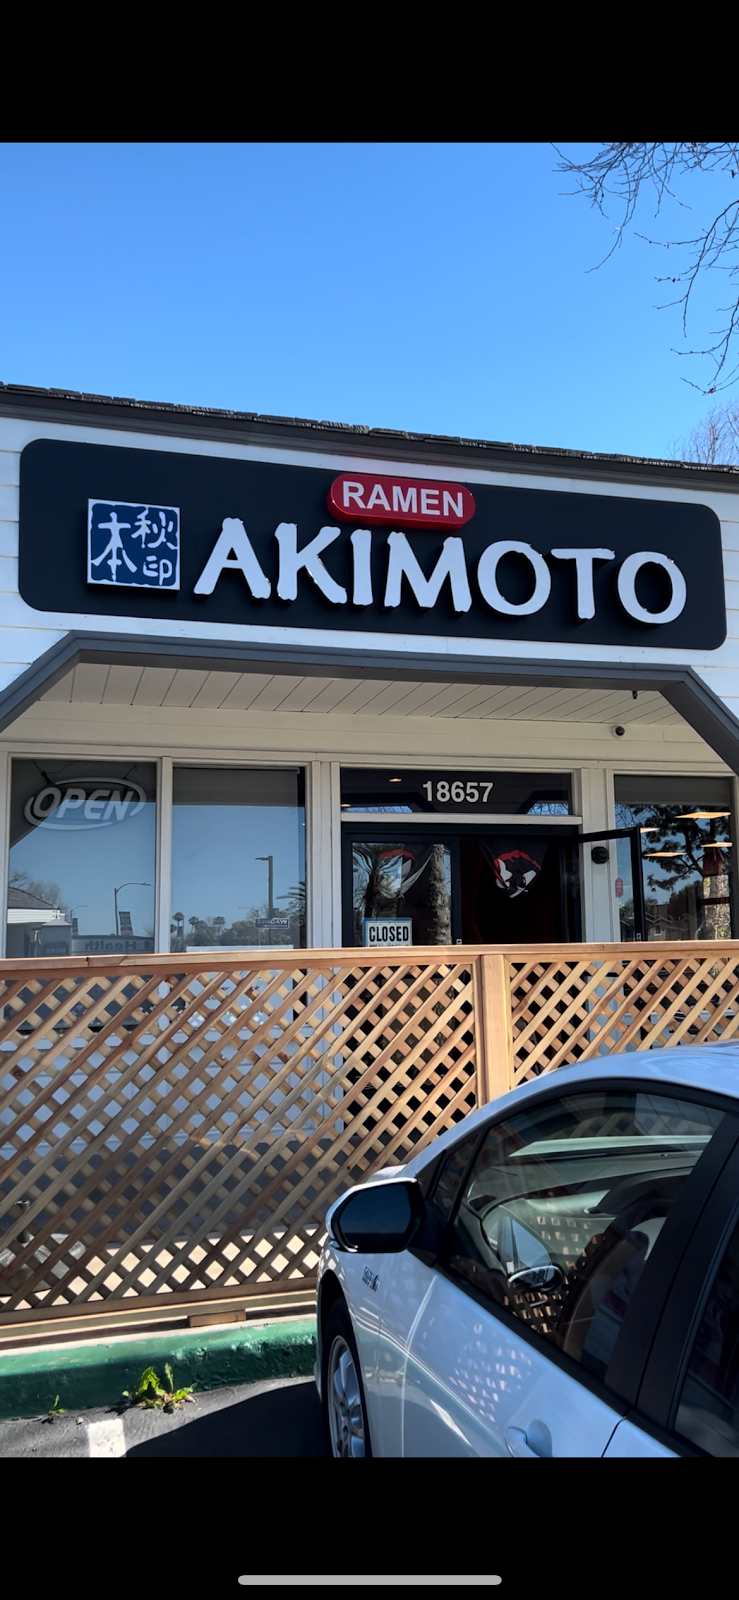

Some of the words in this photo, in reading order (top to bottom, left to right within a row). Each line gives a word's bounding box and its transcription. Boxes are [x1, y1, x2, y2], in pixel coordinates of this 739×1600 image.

[343, 481, 463, 517] RAMEN
[194, 518, 687, 625] AKIMOTO
[33, 787, 134, 820] OPEN
[423, 781, 493, 802] 18657
[369, 926, 409, 942] CLOSED
